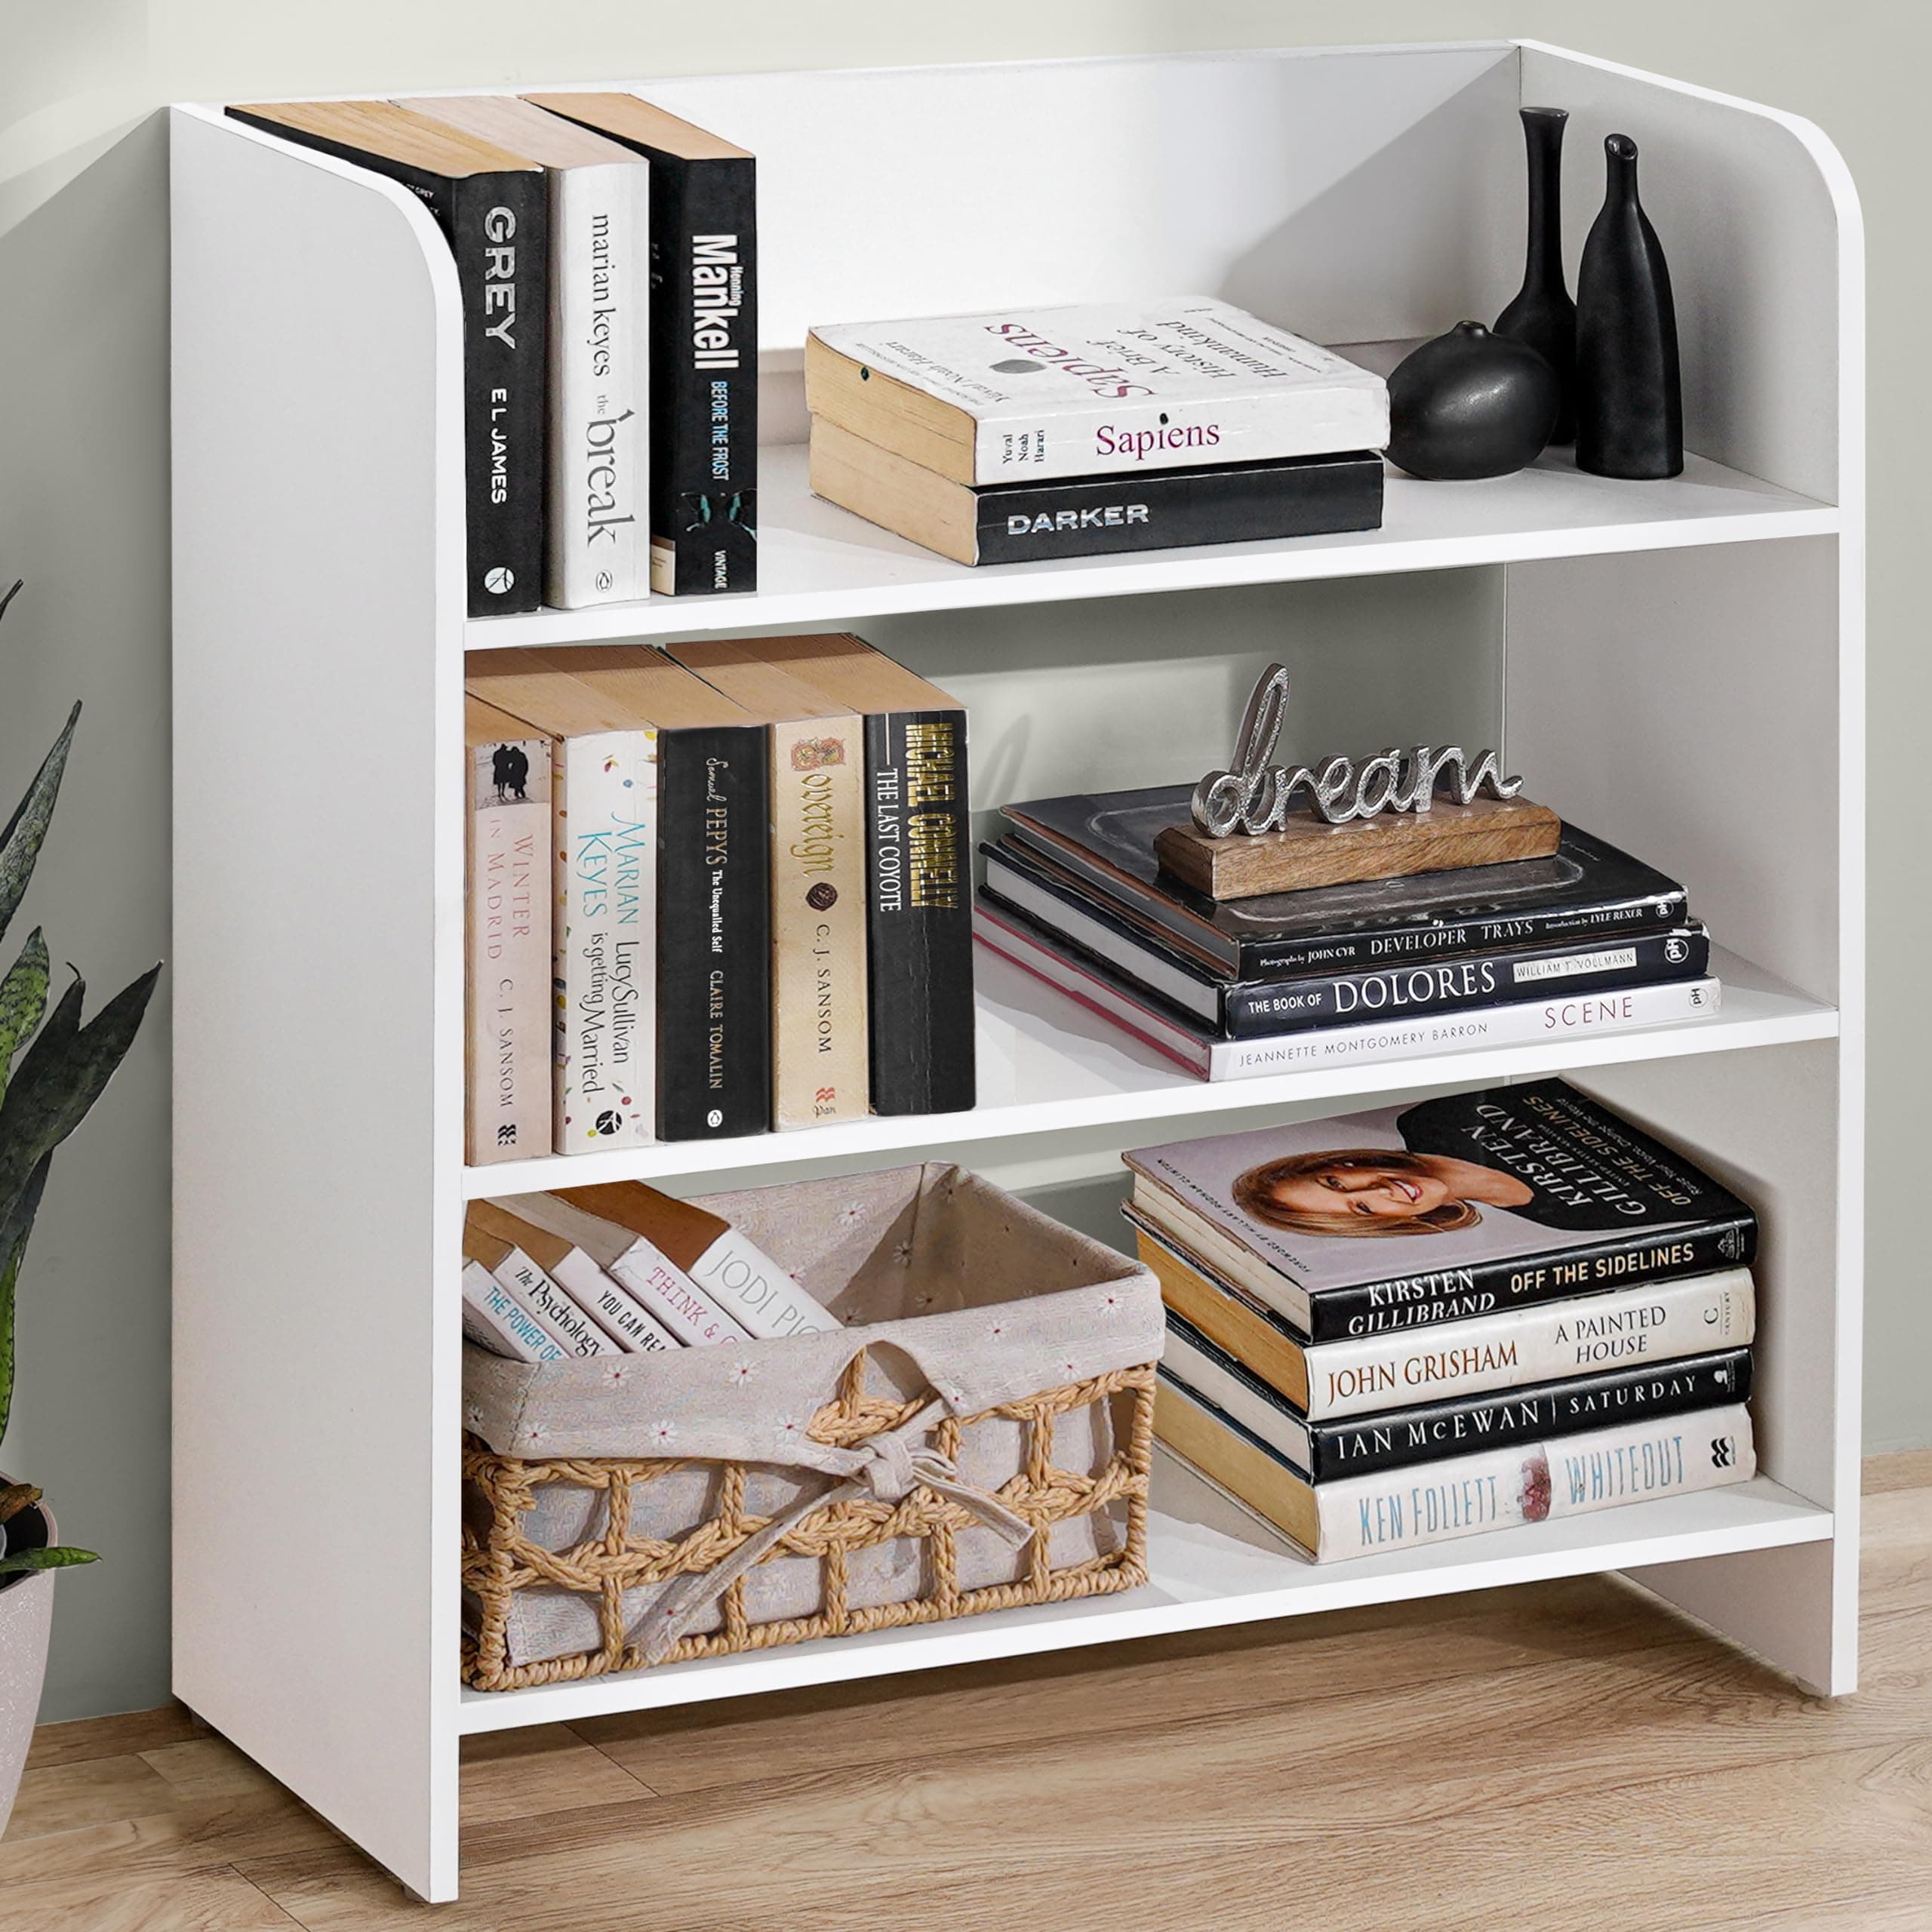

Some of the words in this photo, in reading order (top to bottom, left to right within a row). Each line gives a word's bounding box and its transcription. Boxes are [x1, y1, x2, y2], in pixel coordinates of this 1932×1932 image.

[484, 206, 516, 350] GREY
[592, 214, 615, 302] marian
[692, 235, 740, 369] Mankell
[586, 306, 616, 377] keyes
[1087, 339, 1156, 367] Brief
[1117, 328, 1158, 341] of
[1156, 320, 1288, 378] Humankind
[984, 324, 1157, 398] Sapiens
[1151, 365, 1180, 375] A
[1153, 343, 1236, 378] History
[491, 388, 507, 402] E
[491, 408, 507, 422] L
[597, 394, 610, 415] the
[711, 380, 728, 422] BEFORE
[712, 423, 729, 444] THE
[1002, 434, 1014, 464] Yuval
[1019, 433, 1029, 462] Noah
[1034, 429, 1045, 463] Harari
[1096, 420, 1221, 462] Sapiens
[491, 428, 507, 504] JAMES
[586, 408, 635, 549] break
[712, 446, 730, 481] FROST
[1007, 503, 1150, 536] DARKER
[714, 549, 728, 589] VINTAGE
[906, 723, 955, 808] MICHAEL
[1190, 662, 1524, 839] dream
[706, 757, 730, 802] Samuel
[876, 768, 899, 801] THE
[489, 819, 502, 838] IN
[706, 808, 728, 866] PEPYS
[877, 804, 900, 843] LAST
[512, 834, 534, 938] WINTER
[576, 832, 614, 918] KEYES
[611, 812, 646, 924] MARIAN
[712, 869, 723, 886] The
[878, 846, 902, 912] COYOTE
[907, 814, 959, 909] CONNELLY
[487, 853, 506, 960] MADRID
[709, 887, 723, 934] Unequalled
[712, 935, 723, 954] Self
[812, 947, 831, 961] J.
[816, 924, 831, 943] C.
[1307, 948, 1335, 964] JOHN
[1335, 946, 1357, 958] CYR
[1371, 928, 1467, 955] DEVELOPER
[1481, 919, 1534, 940] TRAYS
[1590, 911, 1614, 924] LYLE
[1613, 907, 1644, 920] REXER
[499, 979, 514, 998] C.
[609, 942, 640, 987] Lucy
[1247, 1000, 1271, 1014] THE
[1273, 995, 1305, 1011] BOOK
[1307, 992, 1323, 1006] OF
[1333, 961, 1497, 1014] DOLORES
[1515, 963, 1561, 978] WILLIAM
[1576, 952, 1635, 970] VOLLMANN
[497, 1007, 514, 1019] J.
[709, 970, 724, 1019] CLAIRE
[817, 968, 832, 1054] SANSOM
[579, 1003, 606, 1094] Married
[611, 985, 639, 1064] Sullivan
[1239, 1045, 1318, 1067] JEANNETTE
[1324, 1031, 1426, 1055] MONTGOMERY
[1432, 1022, 1487, 1041] BARRON
[1545, 996, 1633, 1029] SCENE
[499, 1028, 515, 1107] SANSOM
[709, 1024, 724, 1090] TOMALIN
[1522, 1096, 1619, 1156] SIDELINES
[1461, 1125, 1595, 1207] KIRSTEN
[1476, 1104, 1647, 1215] GILLIBRAND
[1611, 1155, 1654, 1182] THE
[1648, 1183, 1692, 1206] OFF
[703, 1250, 779, 1315] JODI
[1367, 1268, 1475, 1308] KIRSTEN
[1510, 1269, 1547, 1294] OFF
[1552, 1261, 1589, 1286] THE
[1595, 1242, 1695, 1278] SIDELINES
[484, 1286, 511, 1315] THE
[503, 1307, 546, 1351] POWER
[539, 1345, 563, 1361] OF
[515, 1266, 534, 1287] The
[528, 1278, 605, 1358] Psychology
[597, 1290, 623, 1315] YOU
[618, 1312, 646, 1338] CAN
[646, 1266, 708, 1326] THINK
[703, 1323, 719, 1339] &
[1348, 1292, 1496, 1336] GILLIBRAND
[1555, 1323, 1570, 1345] A
[1575, 1305, 1667, 1340] PAINTED
[1327, 1361, 1395, 1407] JOHN
[1404, 1340, 1518, 1388] GRISHAM
[1576, 1334, 1647, 1364] HOUSE
[1337, 1426, 1392, 1460] IAN
[1570, 1375, 1697, 1415] SATURDAY
[1358, 1494, 1404, 1546] KEN
[1411, 1475, 1497, 1537] FOLLETT
[1565, 1435, 1682, 1505] WHITEOUT
